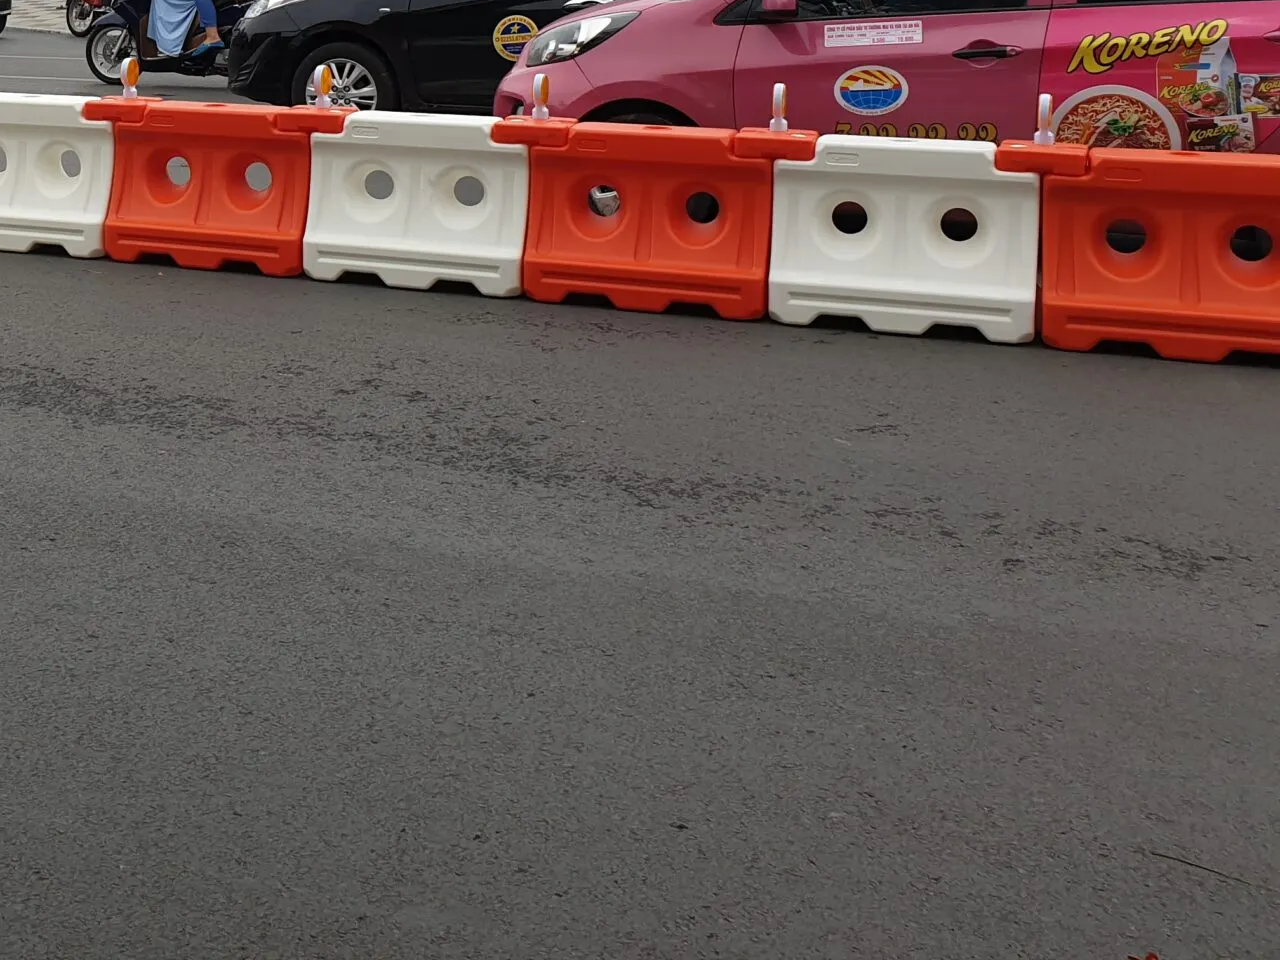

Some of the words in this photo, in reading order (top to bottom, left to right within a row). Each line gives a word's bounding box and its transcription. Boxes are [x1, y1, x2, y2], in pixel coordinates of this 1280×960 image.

[1066, 18, 1229, 75] KORENO
[1159, 81, 1209, 99] KORENO
[1187, 123, 1239, 143] KORENO
